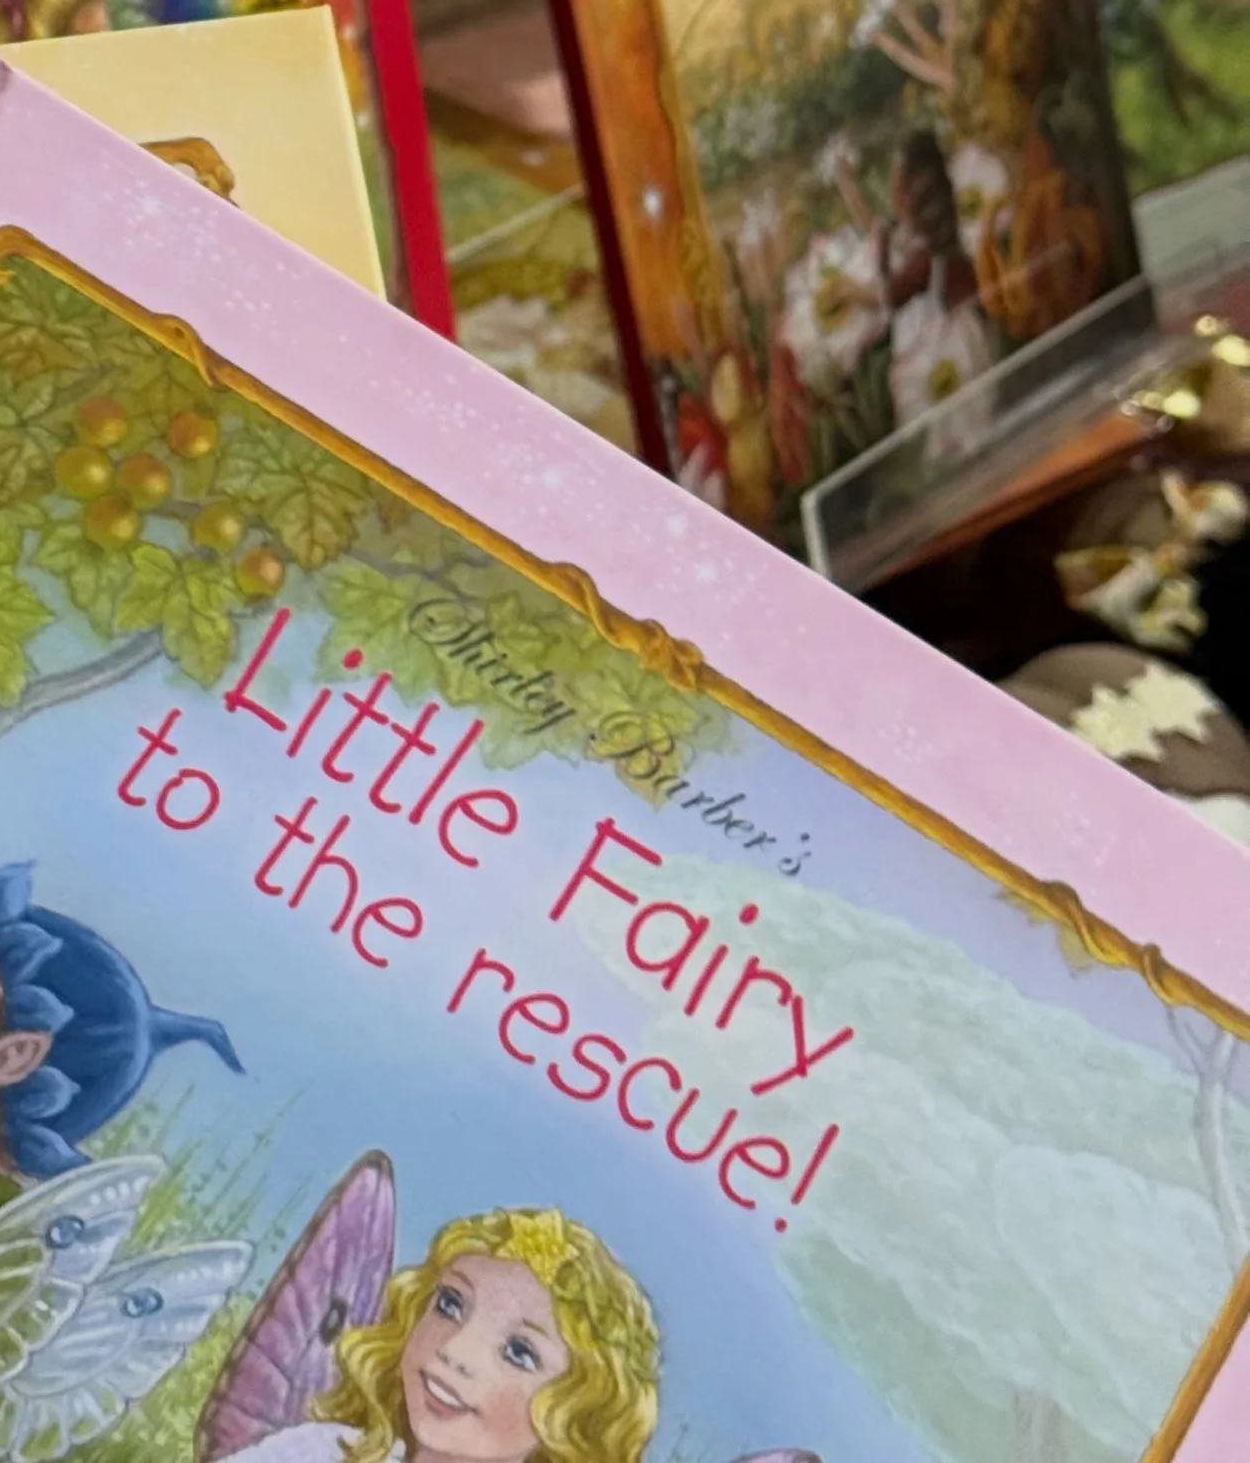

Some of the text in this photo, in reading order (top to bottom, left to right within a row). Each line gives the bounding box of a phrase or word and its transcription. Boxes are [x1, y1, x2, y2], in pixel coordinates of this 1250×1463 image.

[117, 708, 840, 1234] to the rescue!
[223, 606, 854, 1096] Little Fairy
[408, 593, 812, 877] Shirley Barber's
